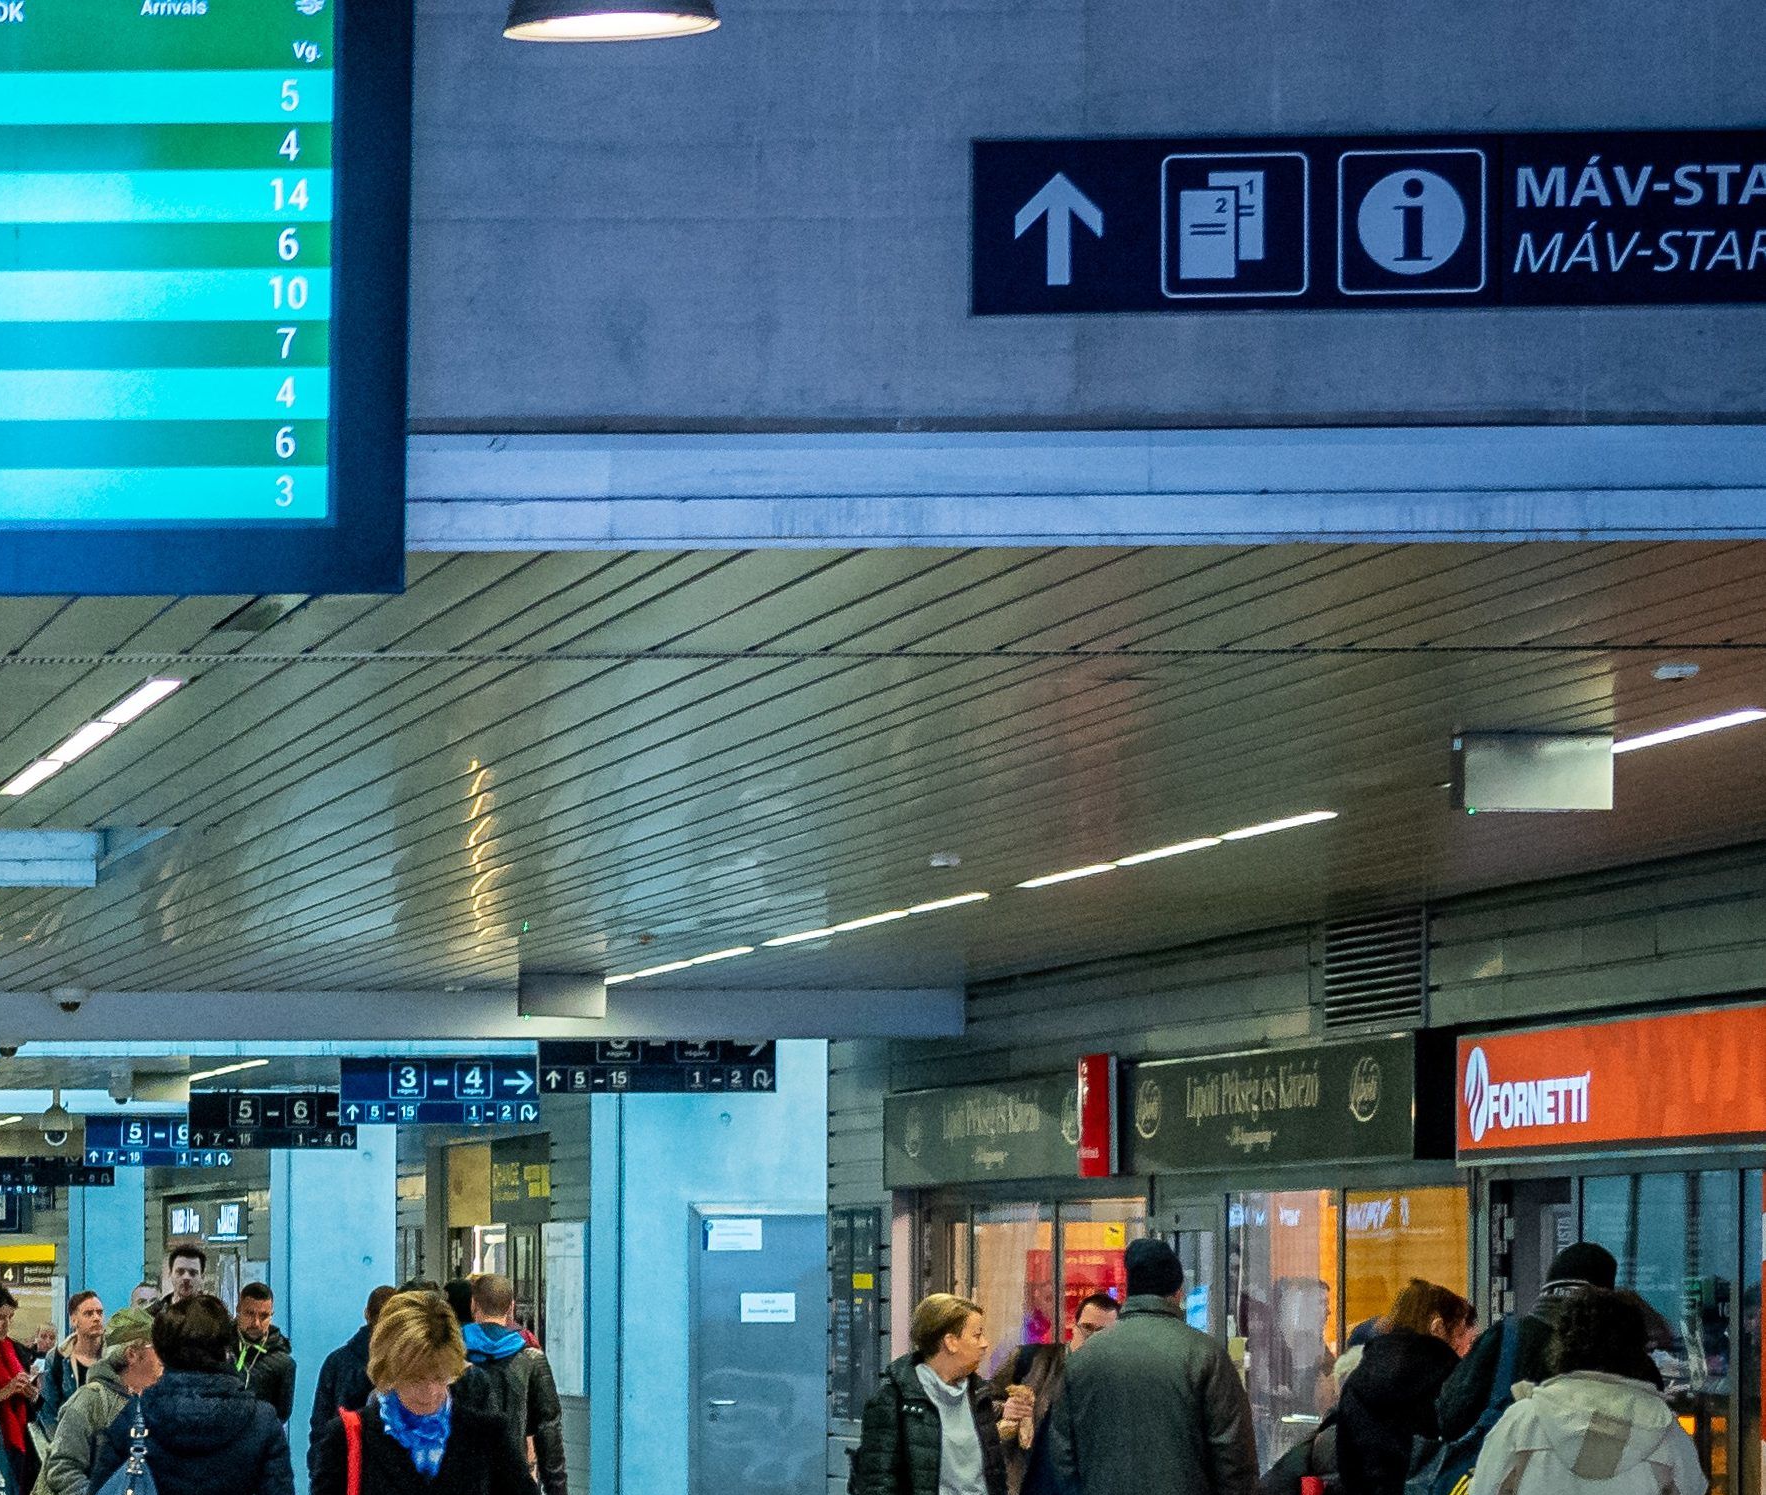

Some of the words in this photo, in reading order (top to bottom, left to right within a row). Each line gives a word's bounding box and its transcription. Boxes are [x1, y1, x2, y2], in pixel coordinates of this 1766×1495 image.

[140, 0, 207, 16] Arrivals
[292, 41, 323, 63] Vg.
[280, 79, 300, 112] 5
[279, 129, 300, 162] 4
[270, 178, 309, 211] 14
[278, 227, 299, 262] 6
[268, 275, 309, 310] 10
[276, 327, 297, 359] 7
[275, 376, 296, 409] 4
[275, 425, 296, 458] 6
[275, 474, 294, 508] 3
[399, 1066, 417, 1088] 3
[465, 1066, 484, 1088] 4
[239, 1101, 252, 1119] 5
[294, 1101, 308, 1119] 6
[1488, 1070, 1591, 1129] FORNETTI
[129, 1123, 143, 1140] 5
